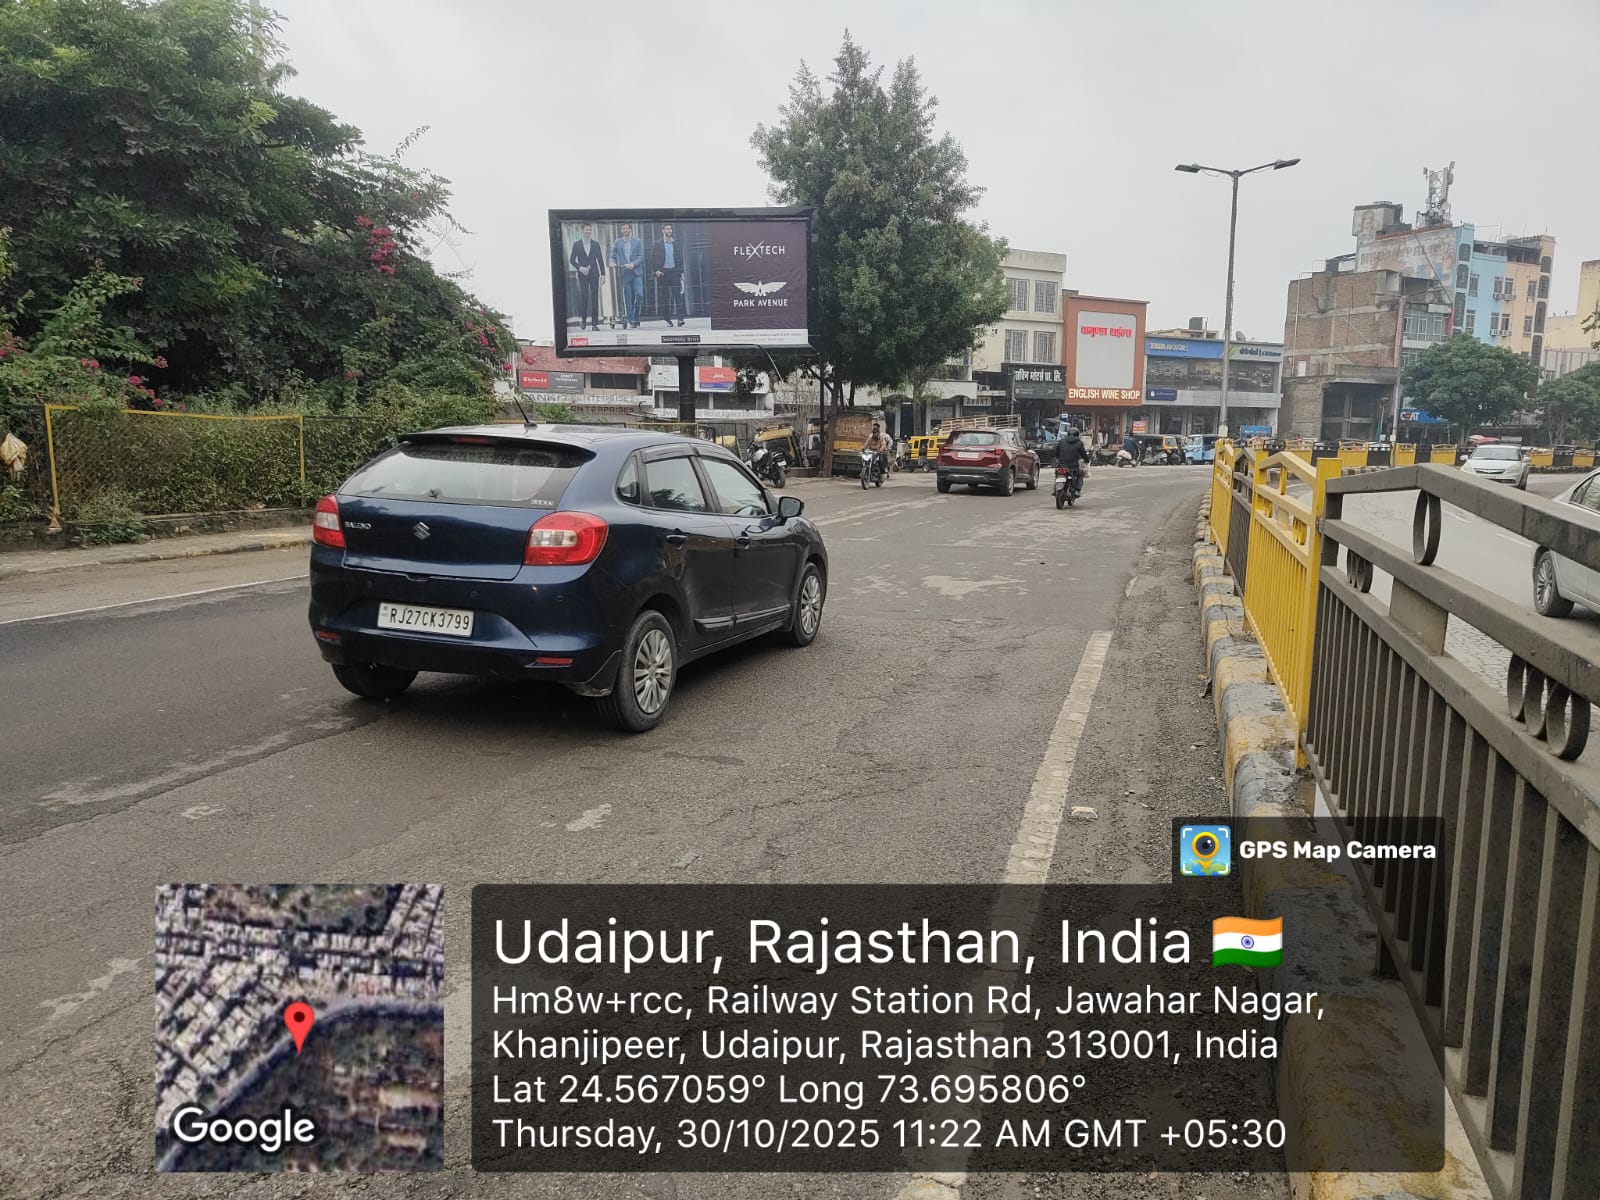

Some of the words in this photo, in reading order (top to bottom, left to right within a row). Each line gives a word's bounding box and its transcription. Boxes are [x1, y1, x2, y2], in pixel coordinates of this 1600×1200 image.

[733, 240, 785, 261] FLEXTECH
[733, 299, 755, 307] PARK
[758, 298, 788, 307] AVENUE
[1068, 388, 1100, 399] ENGLISH
[1101, 389, 1120, 400] WINE
[1120, 390, 1141, 401] SHOP
[570, 405, 635, 413] ENTERPRISES
[389, 608, 470, 630] RJ27CK3799
